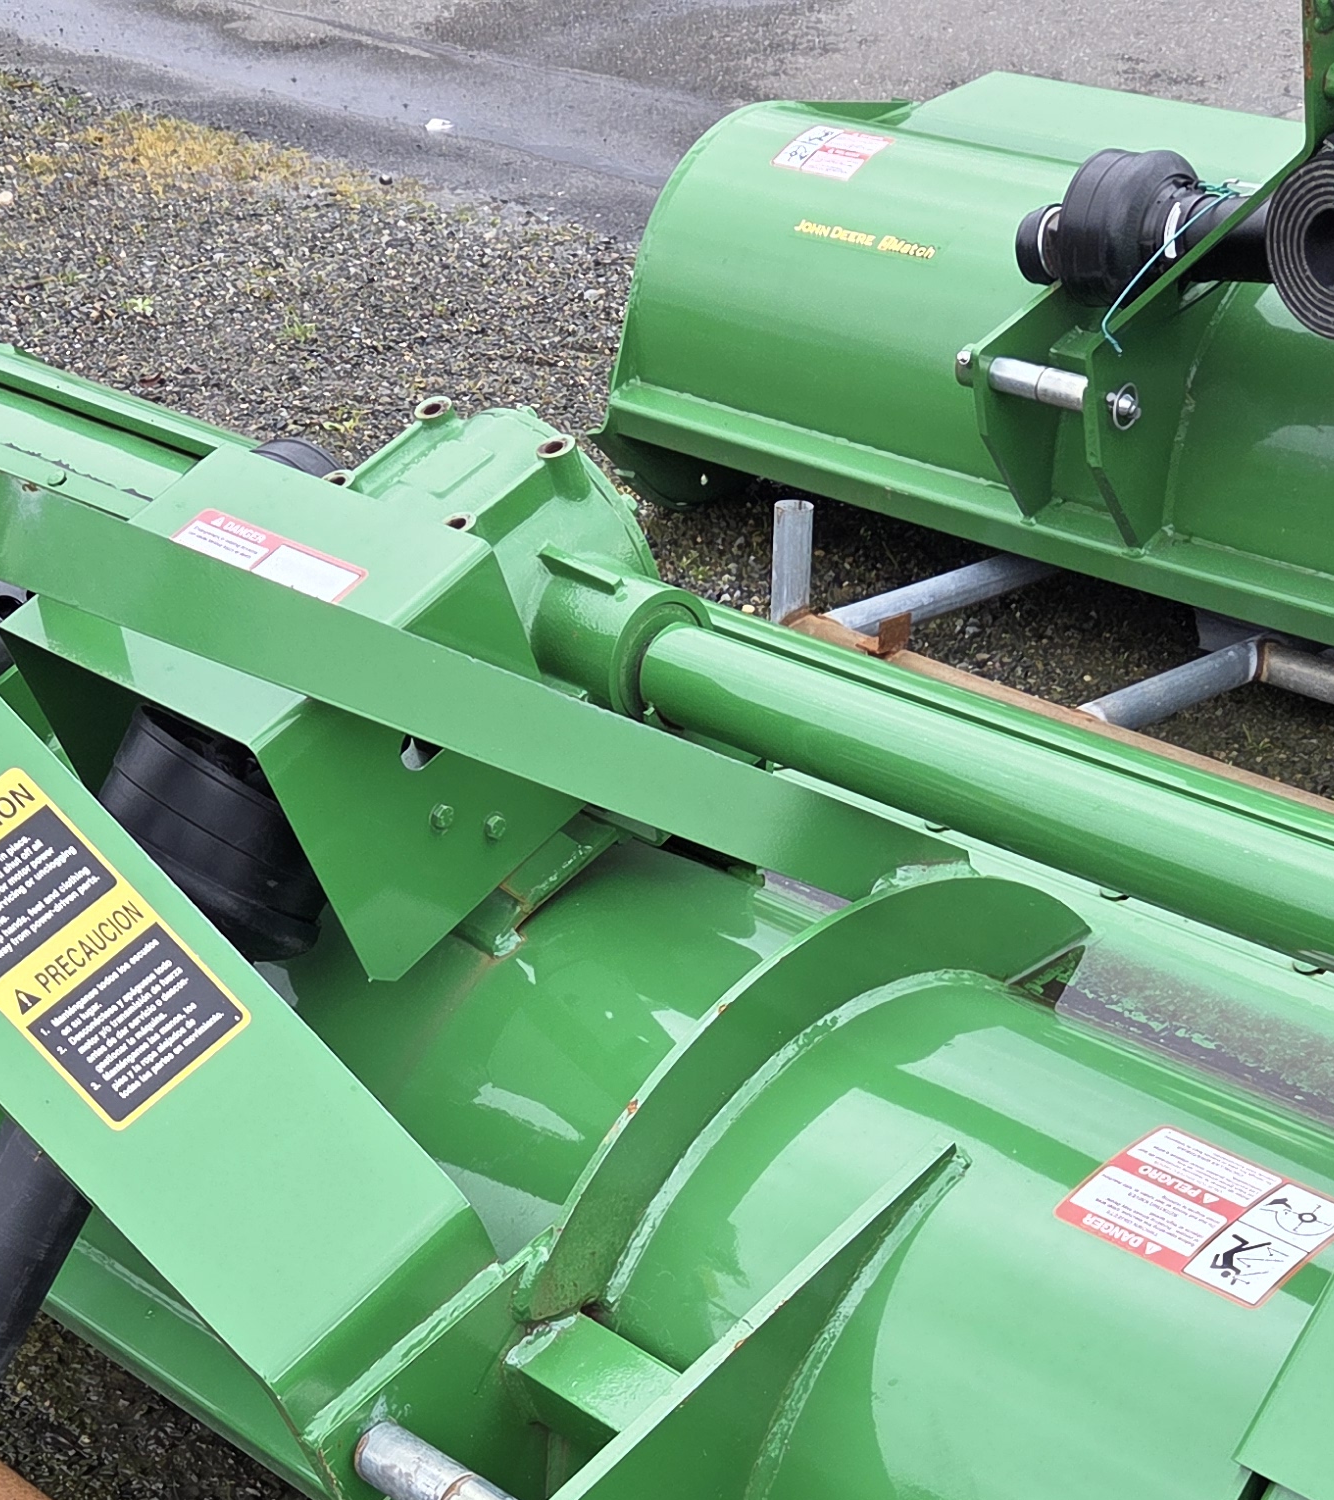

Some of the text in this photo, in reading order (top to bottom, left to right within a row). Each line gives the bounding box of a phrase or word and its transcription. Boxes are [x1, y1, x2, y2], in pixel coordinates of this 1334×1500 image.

[829, 226, 876, 246] DEERE
[223, 520, 267, 544] DANGER
[33, 900, 145, 994] PRECAUCION
[1137, 1164, 1201, 1198] PELIGRO
[1081, 1212, 1144, 1250] DANGER
